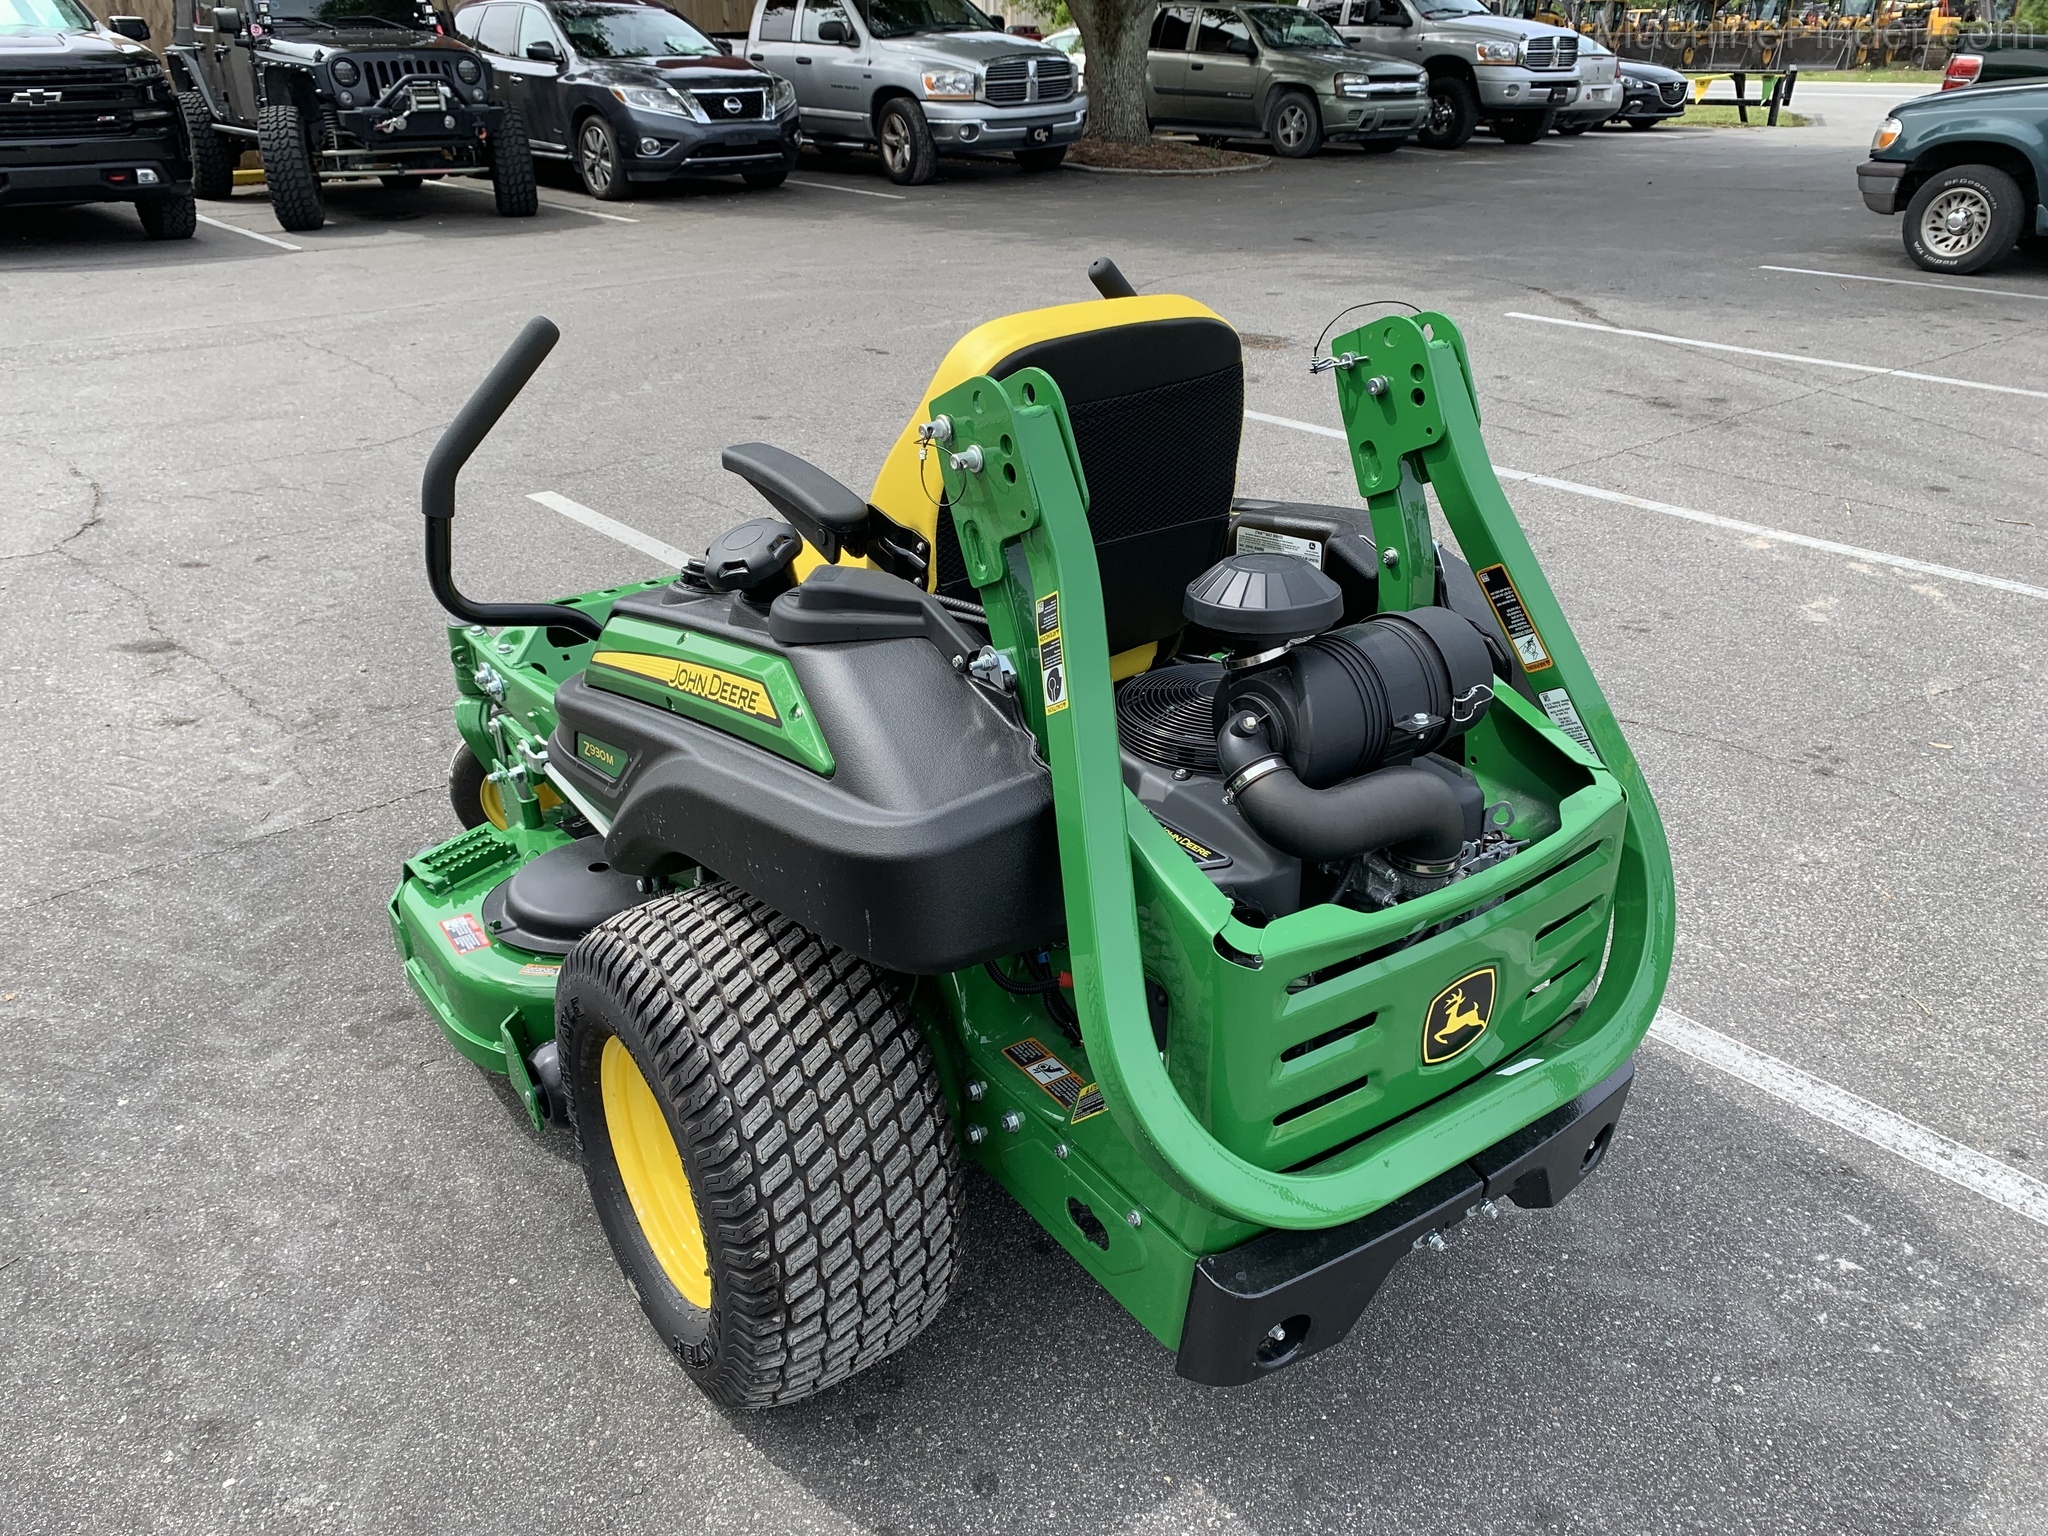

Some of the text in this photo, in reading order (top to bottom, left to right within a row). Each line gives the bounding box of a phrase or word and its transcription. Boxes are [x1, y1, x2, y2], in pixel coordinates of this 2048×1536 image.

[1944, 178, 1998, 209] BFGoodrich
[669, 663, 760, 711] JOHN DEERE
[583, 740, 614, 767] Z930M
[1179, 837, 1212, 858] DEERE
